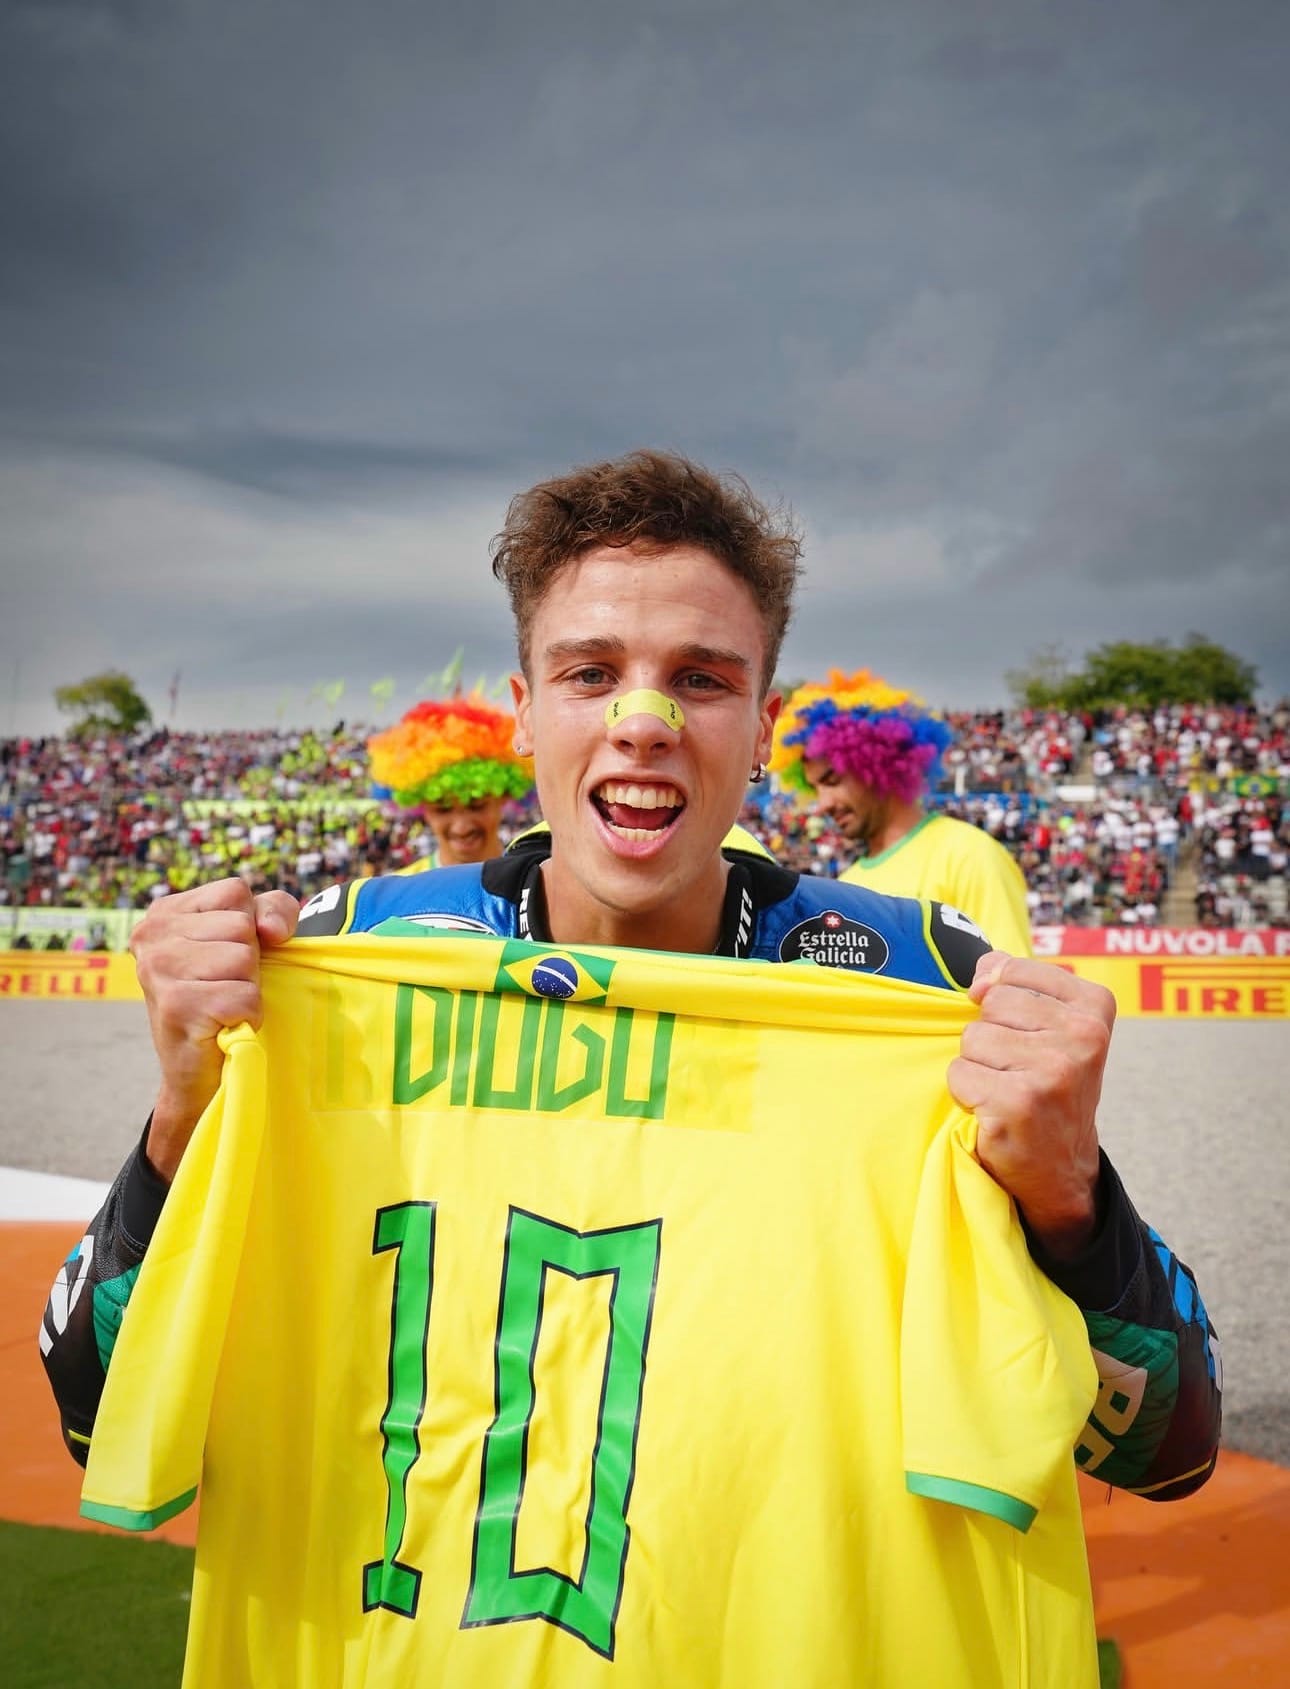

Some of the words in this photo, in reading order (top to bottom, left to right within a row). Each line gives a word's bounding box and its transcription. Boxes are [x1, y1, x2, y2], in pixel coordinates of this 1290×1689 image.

[798, 931, 870, 949] Estrella
[1105, 930, 1267, 956] NUVOLA
[800, 946, 867, 965] Galicia
[362, 1200, 663, 1662] 10
